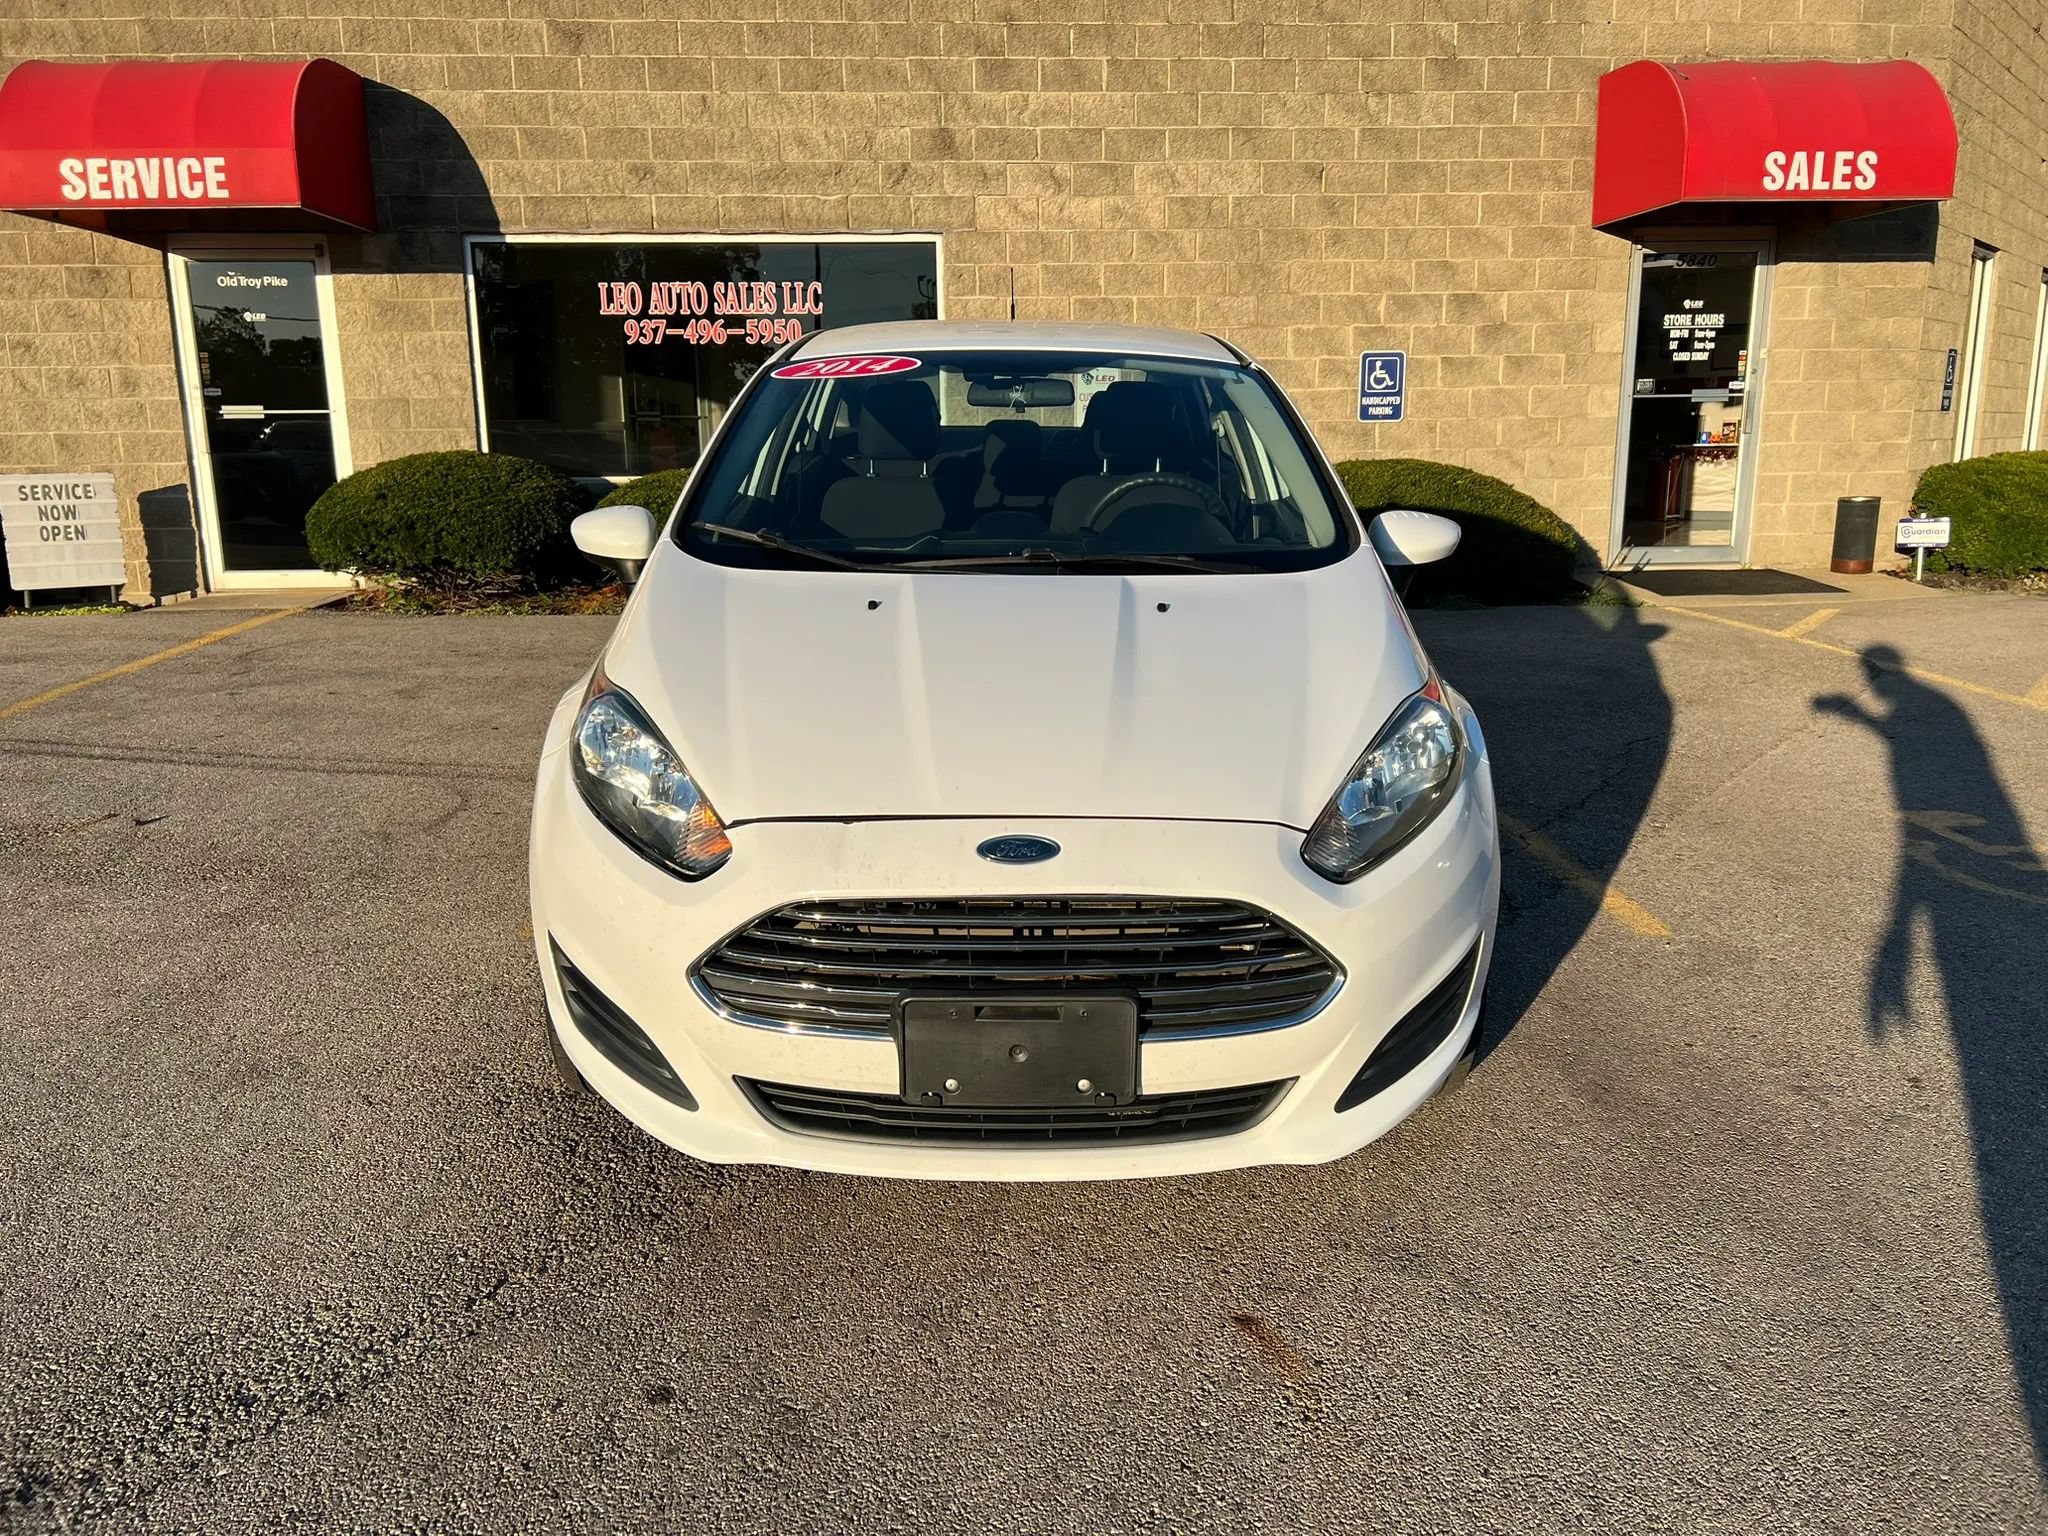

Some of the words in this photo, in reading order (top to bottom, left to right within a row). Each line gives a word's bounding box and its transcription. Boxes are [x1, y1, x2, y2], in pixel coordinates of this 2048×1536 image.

[59, 157, 230, 200] SERVICE
[1763, 151, 1878, 191] SALES
[1676, 254, 1718, 267] 5840
[217, 276, 238, 287] Old
[238, 276, 262, 289] Troy
[263, 276, 288, 287] Pike
[598, 281, 643, 315] LEO
[648, 281, 709, 315] AUTO
[713, 281, 776, 315] SALES
[782, 282, 823, 315] LLC
[1663, 314, 1692, 326] STORE
[1695, 314, 1725, 326] HOURS
[624, 319, 802, 345] 937-496-5950
[1672, 351, 1691, 361] CLOSED
[1691, 351, 1709, 361] SUNDAY
[792, 358, 900, 376] 2014
[1095, 374, 1116, 382] LEO
[1361, 396, 1401, 405] HANDICAPPED
[1368, 406, 1393, 415] PARKING
[18, 483, 93, 501] SERVICE
[38, 504, 77, 521] NOW
[39, 524, 86, 542] OPEN
[1902, 527, 1946, 536] Guardian
[996, 839, 1041, 857] Ford
